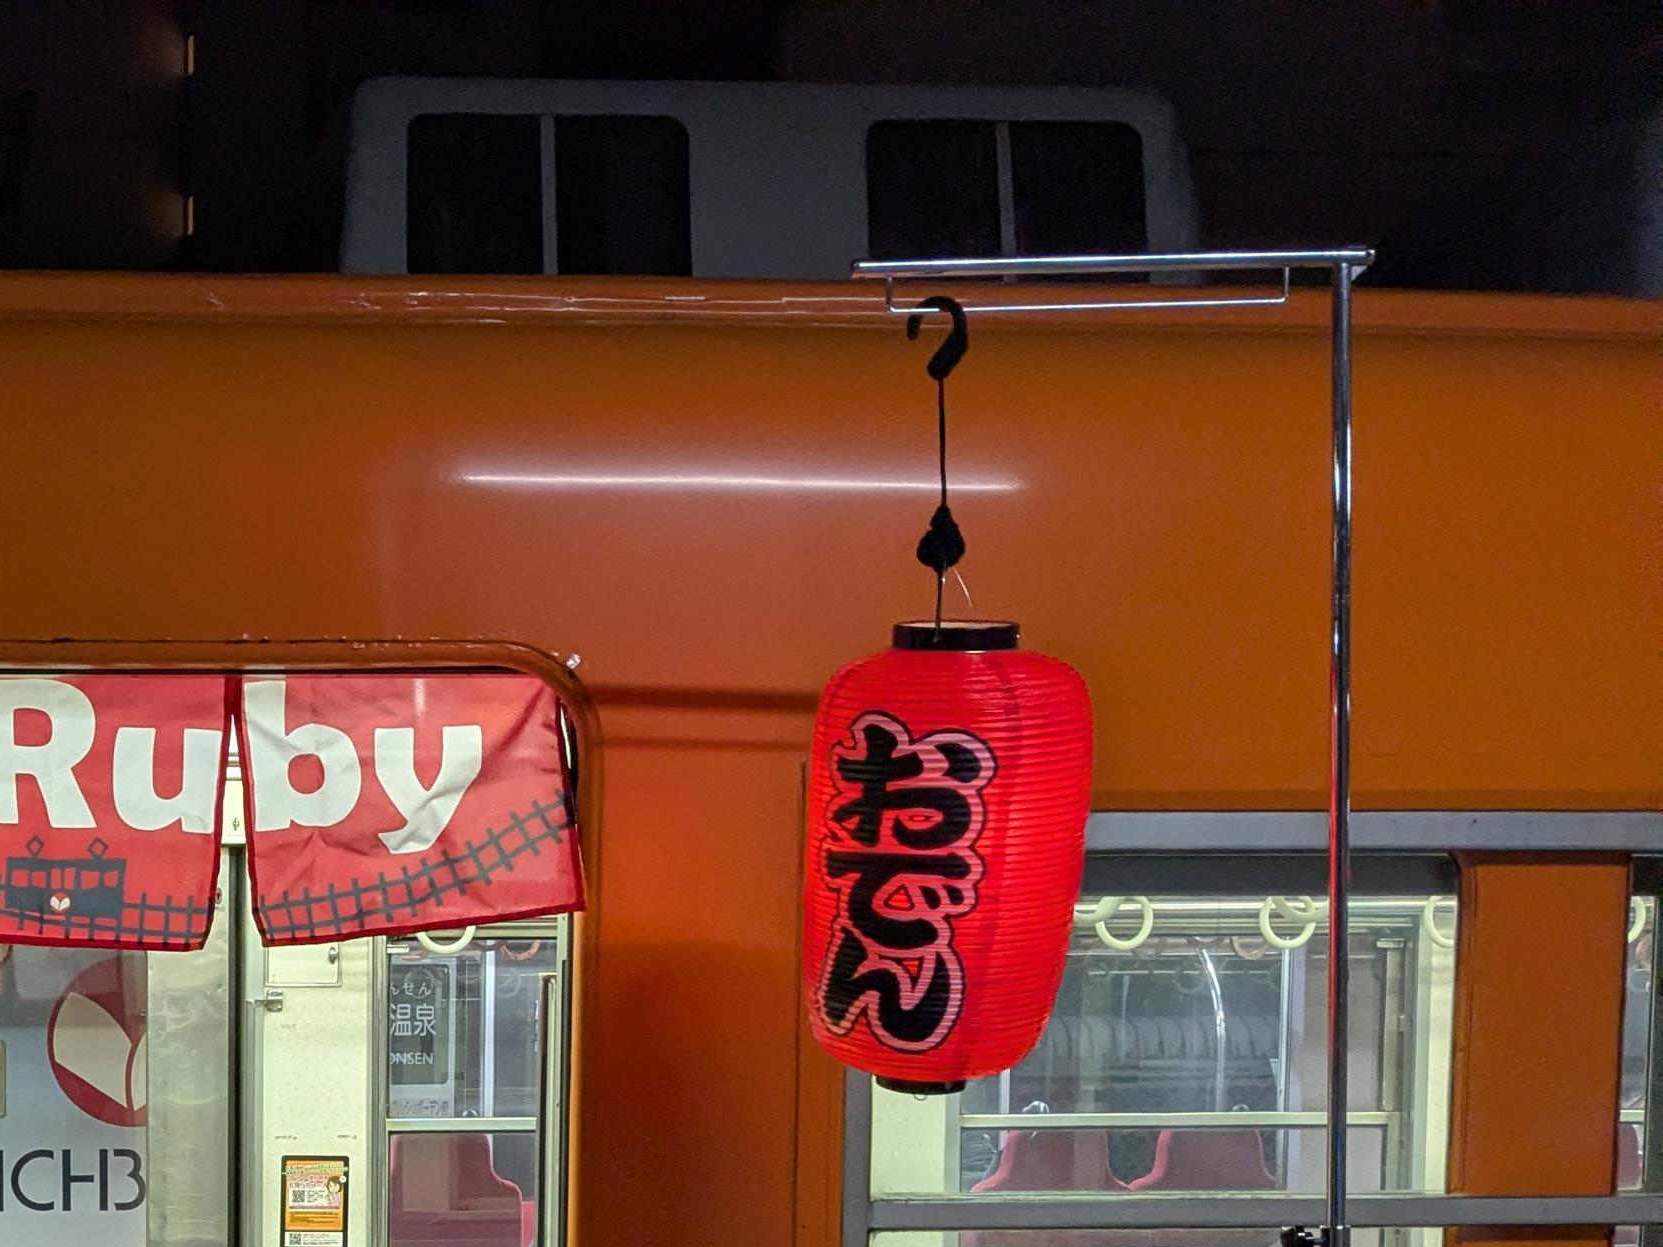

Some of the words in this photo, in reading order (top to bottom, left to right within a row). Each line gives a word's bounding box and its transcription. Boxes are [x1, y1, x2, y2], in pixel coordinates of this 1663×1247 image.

[818, 713, 997, 1051] おでん
[390, 1003, 437, 1036] 温泉
